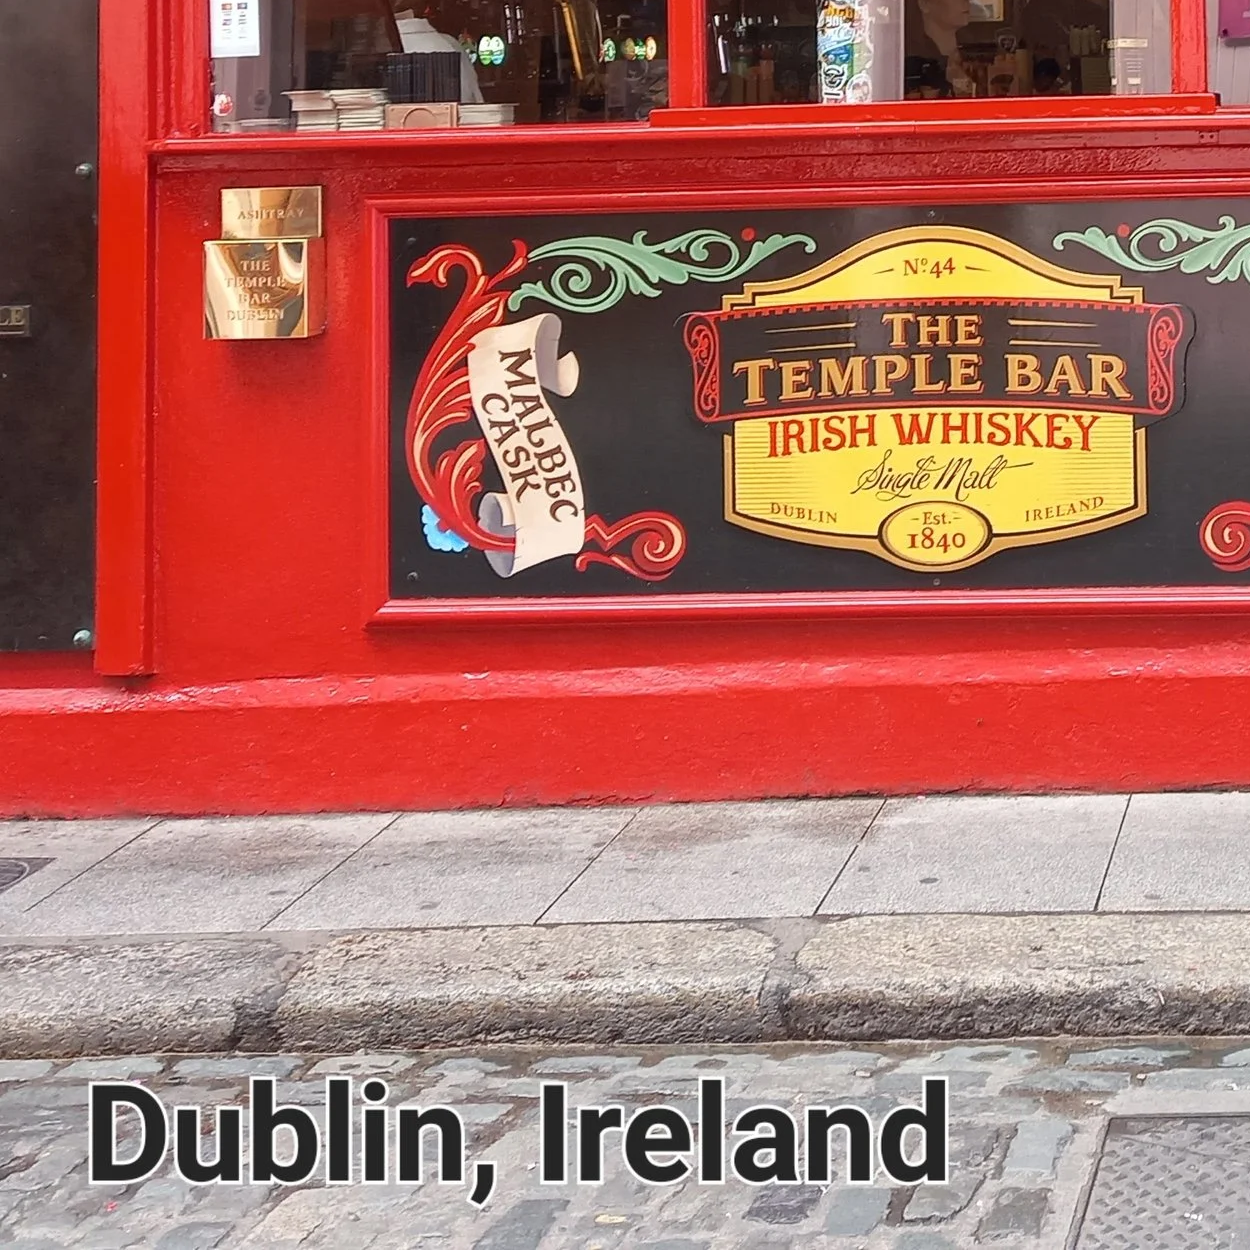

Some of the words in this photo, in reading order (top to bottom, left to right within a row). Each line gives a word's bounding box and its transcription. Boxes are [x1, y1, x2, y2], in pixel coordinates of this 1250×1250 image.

[237, 208, 304, 221] ASHTRAY
[240, 260, 271, 272] THE
[224, 275, 287, 288] TEMPLE
[238, 293, 271, 305] BAR
[226, 308, 285, 322] DUBLIN
[882, 312, 985, 348] THE
[733, 354, 985, 407] TEMPLE
[1003, 353, 1134, 402] BAR
[481, 392, 542, 504] CASK
[498, 347, 579, 523] MALBEC
[766, 413, 878, 458] IRISH
[890, 412, 1102, 453] WHISKEY
[850, 448, 936, 501] Single
[934, 453, 1034, 502] Malt
[770, 501, 838, 525] DUBLIN
[922, 510, 953, 526] Est.
[1024, 495, 1105, 523] IRELAND
[907, 527, 967, 554] 1840
